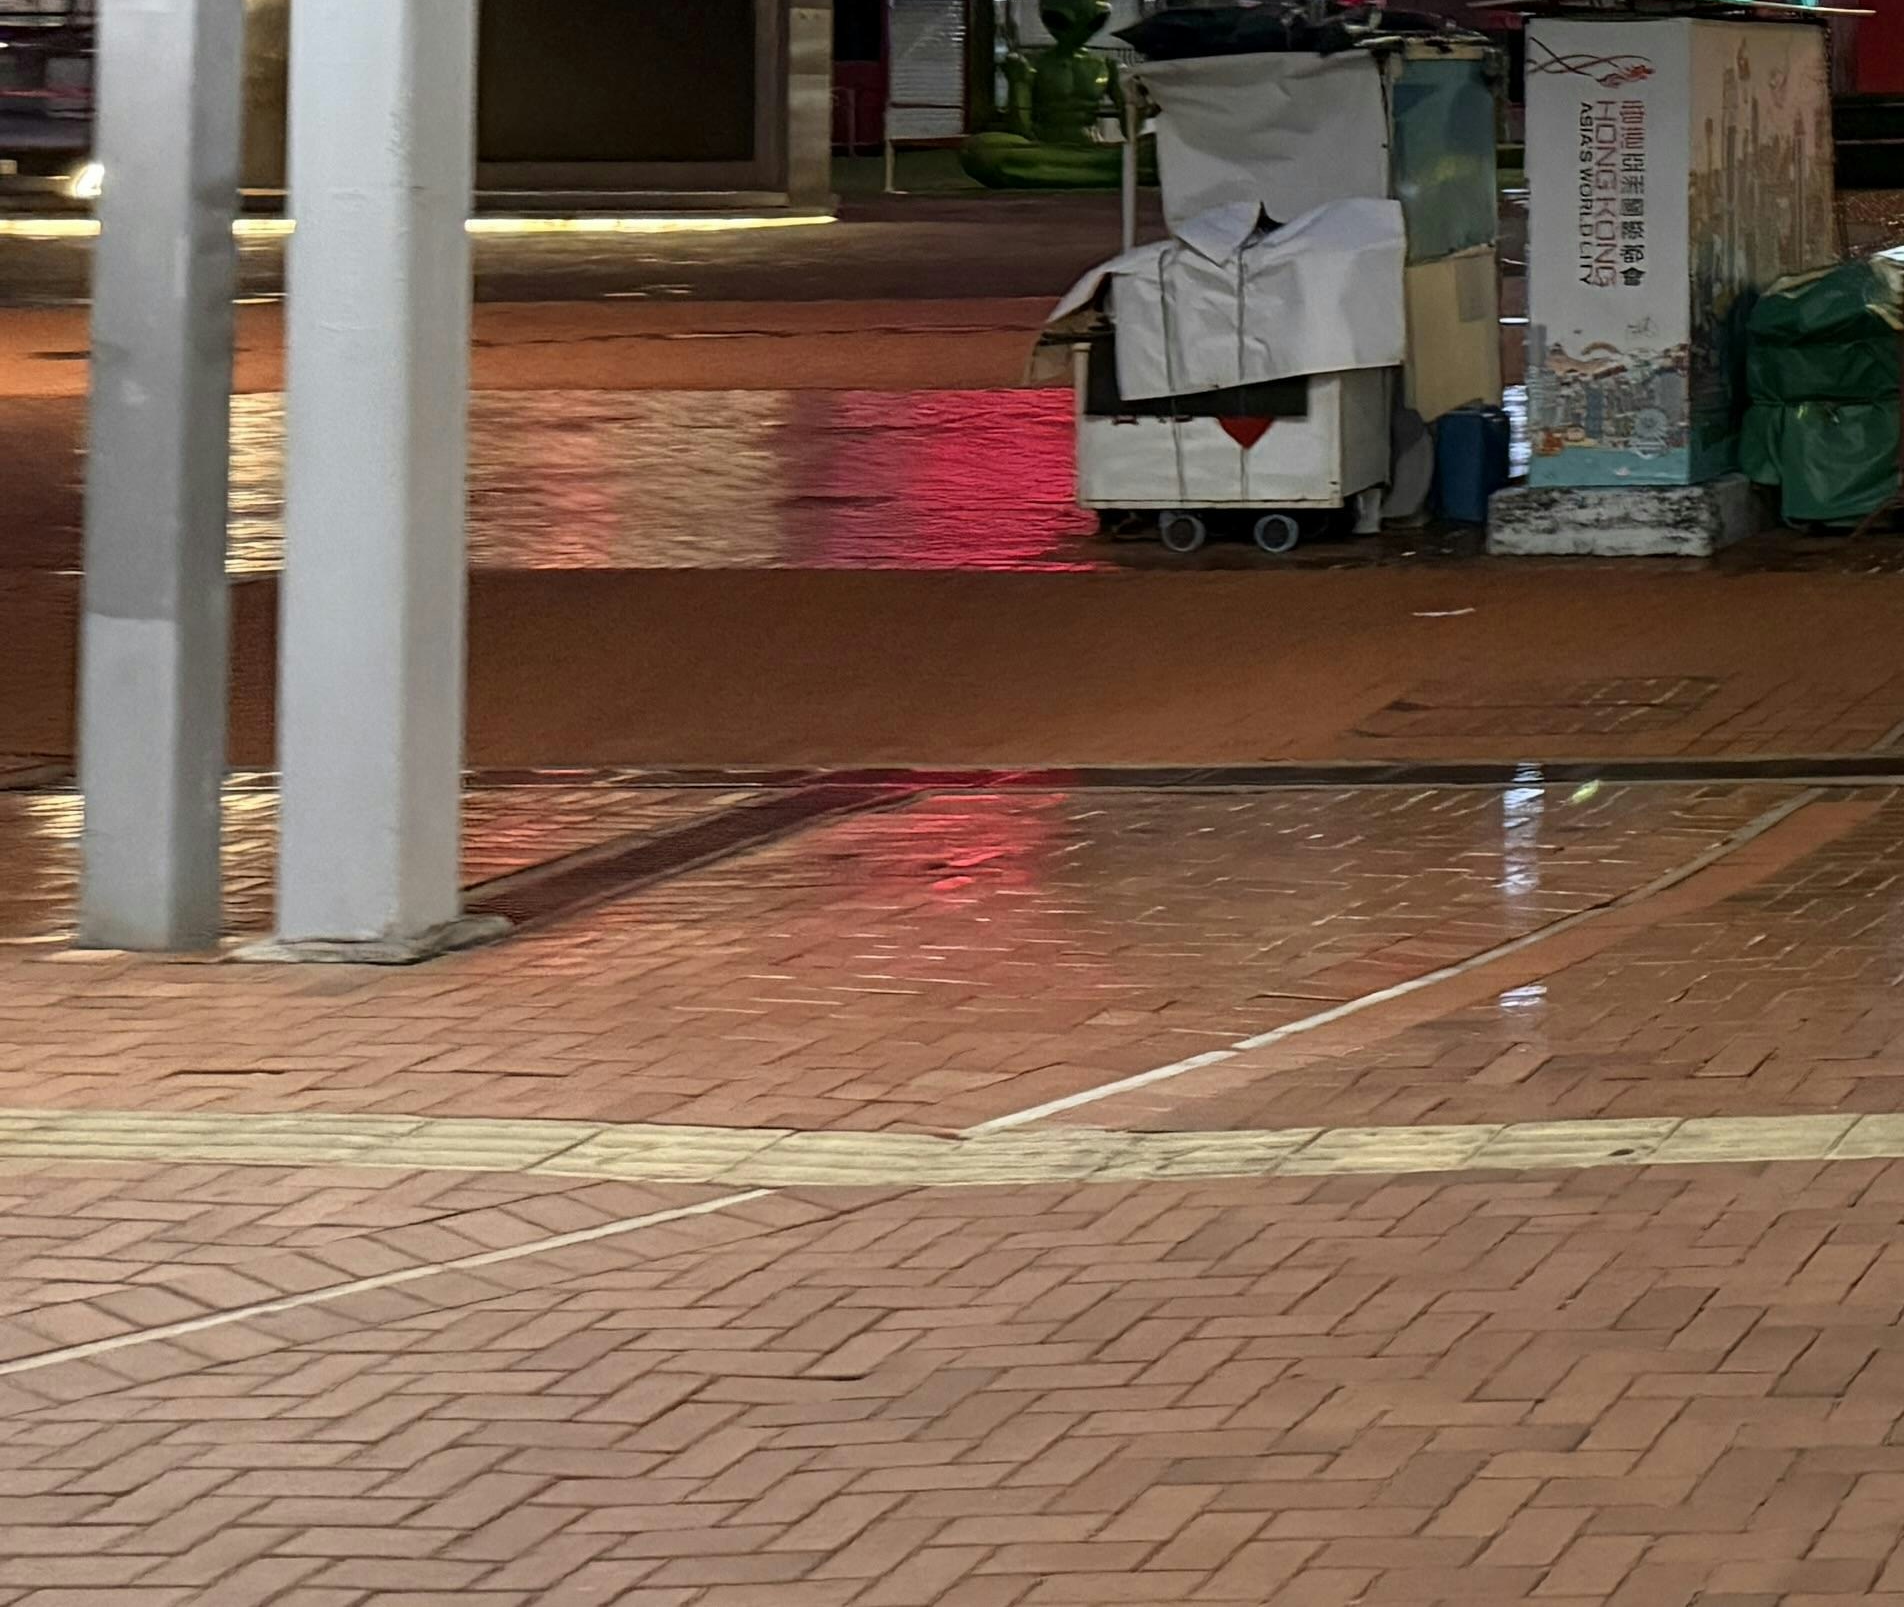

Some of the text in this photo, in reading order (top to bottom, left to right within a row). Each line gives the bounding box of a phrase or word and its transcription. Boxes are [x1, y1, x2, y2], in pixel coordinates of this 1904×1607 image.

[1579, 101, 1594, 286] ASIA'S WORLD CITY
[1594, 100, 1619, 288] HONG KONG
